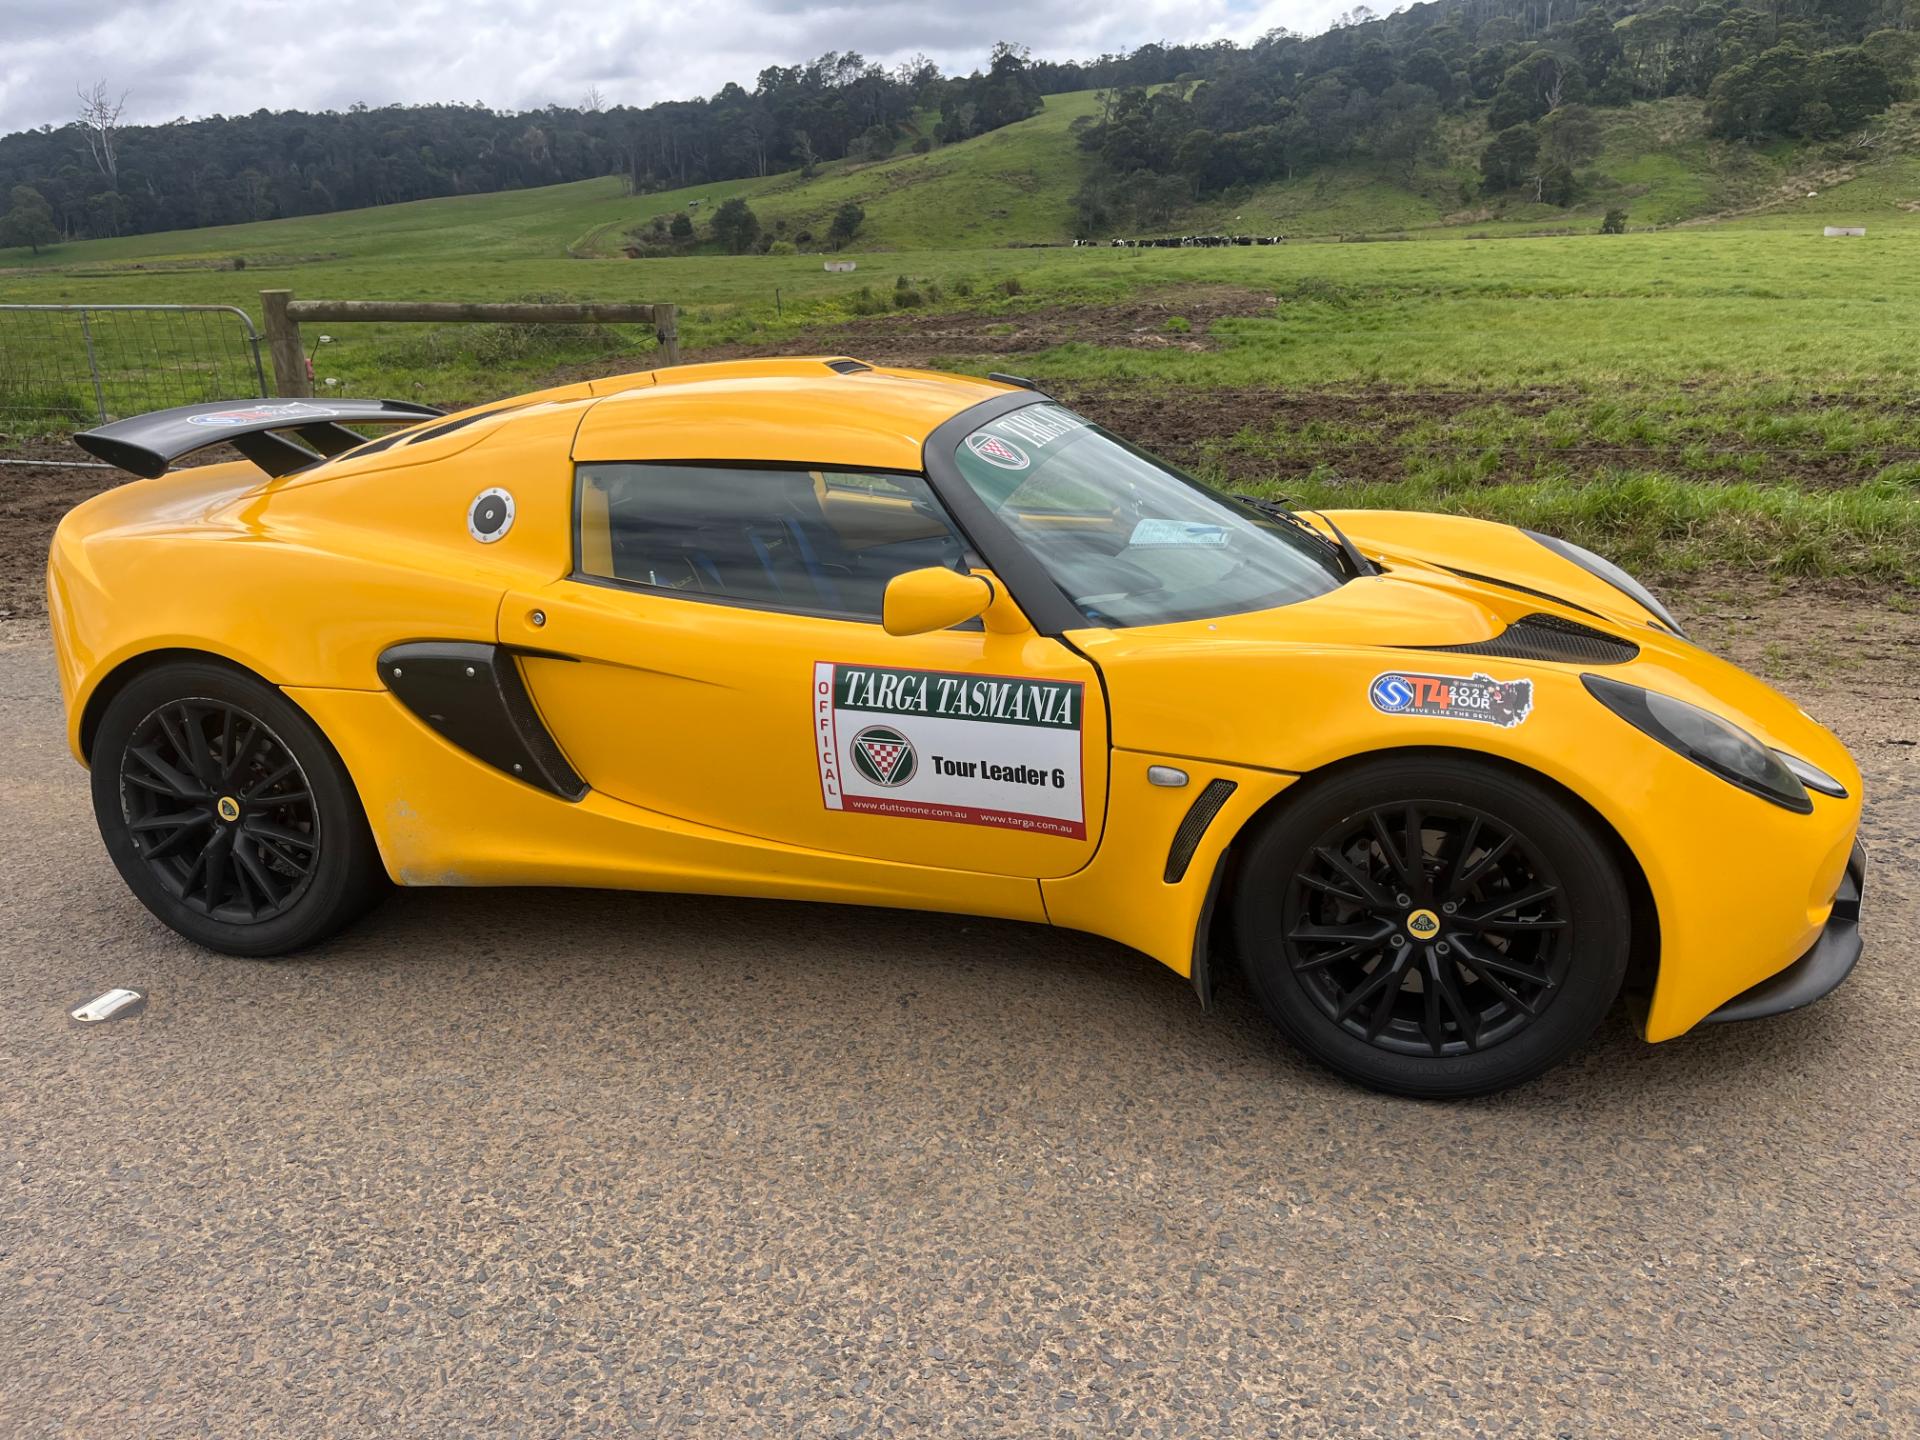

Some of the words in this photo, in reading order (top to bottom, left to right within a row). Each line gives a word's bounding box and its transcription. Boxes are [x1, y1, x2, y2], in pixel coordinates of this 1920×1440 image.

[995, 410, 1071, 448] TARGA
[844, 671, 928, 712] TARGA
[936, 678, 1073, 725] TASMANIA
[1403, 676, 1450, 710] T4
[1449, 686, 1490, 699] 2025
[1449, 695, 1490, 710] TOUR
[1473, 713, 1497, 721] DEVIL
[818, 681, 837, 796] OFFICAL
[931, 755, 977, 778] Tour
[981, 760, 1048, 787] Leader
[1052, 768, 1065, 789] 6
[852, 801, 967, 819] www.duttonone.com.au
[980, 813, 1073, 834] www.targa.com.au
